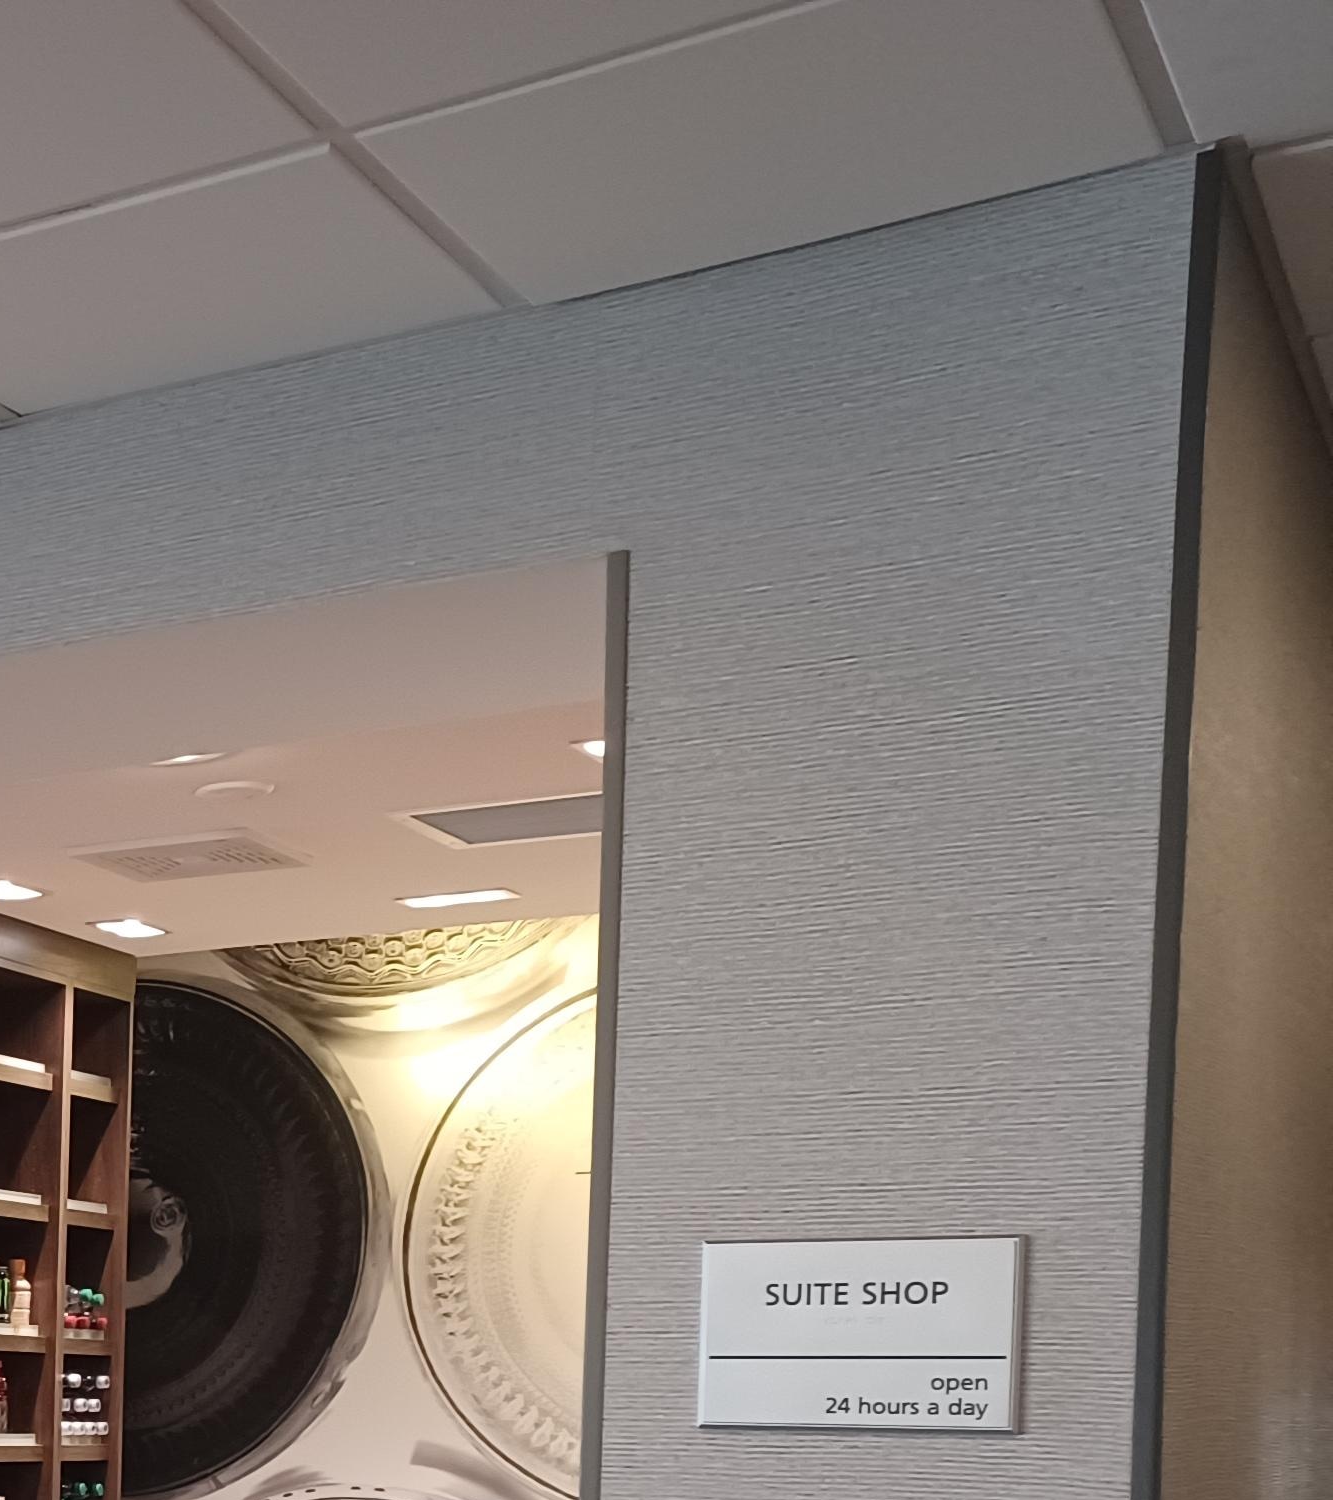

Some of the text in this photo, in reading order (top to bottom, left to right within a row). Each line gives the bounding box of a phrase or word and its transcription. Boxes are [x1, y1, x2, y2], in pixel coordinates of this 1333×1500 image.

[765, 1281, 950, 1306] SUITE SHOP
[930, 1377, 988, 1395] open
[825, 1397, 989, 1421] 24 hours a day
